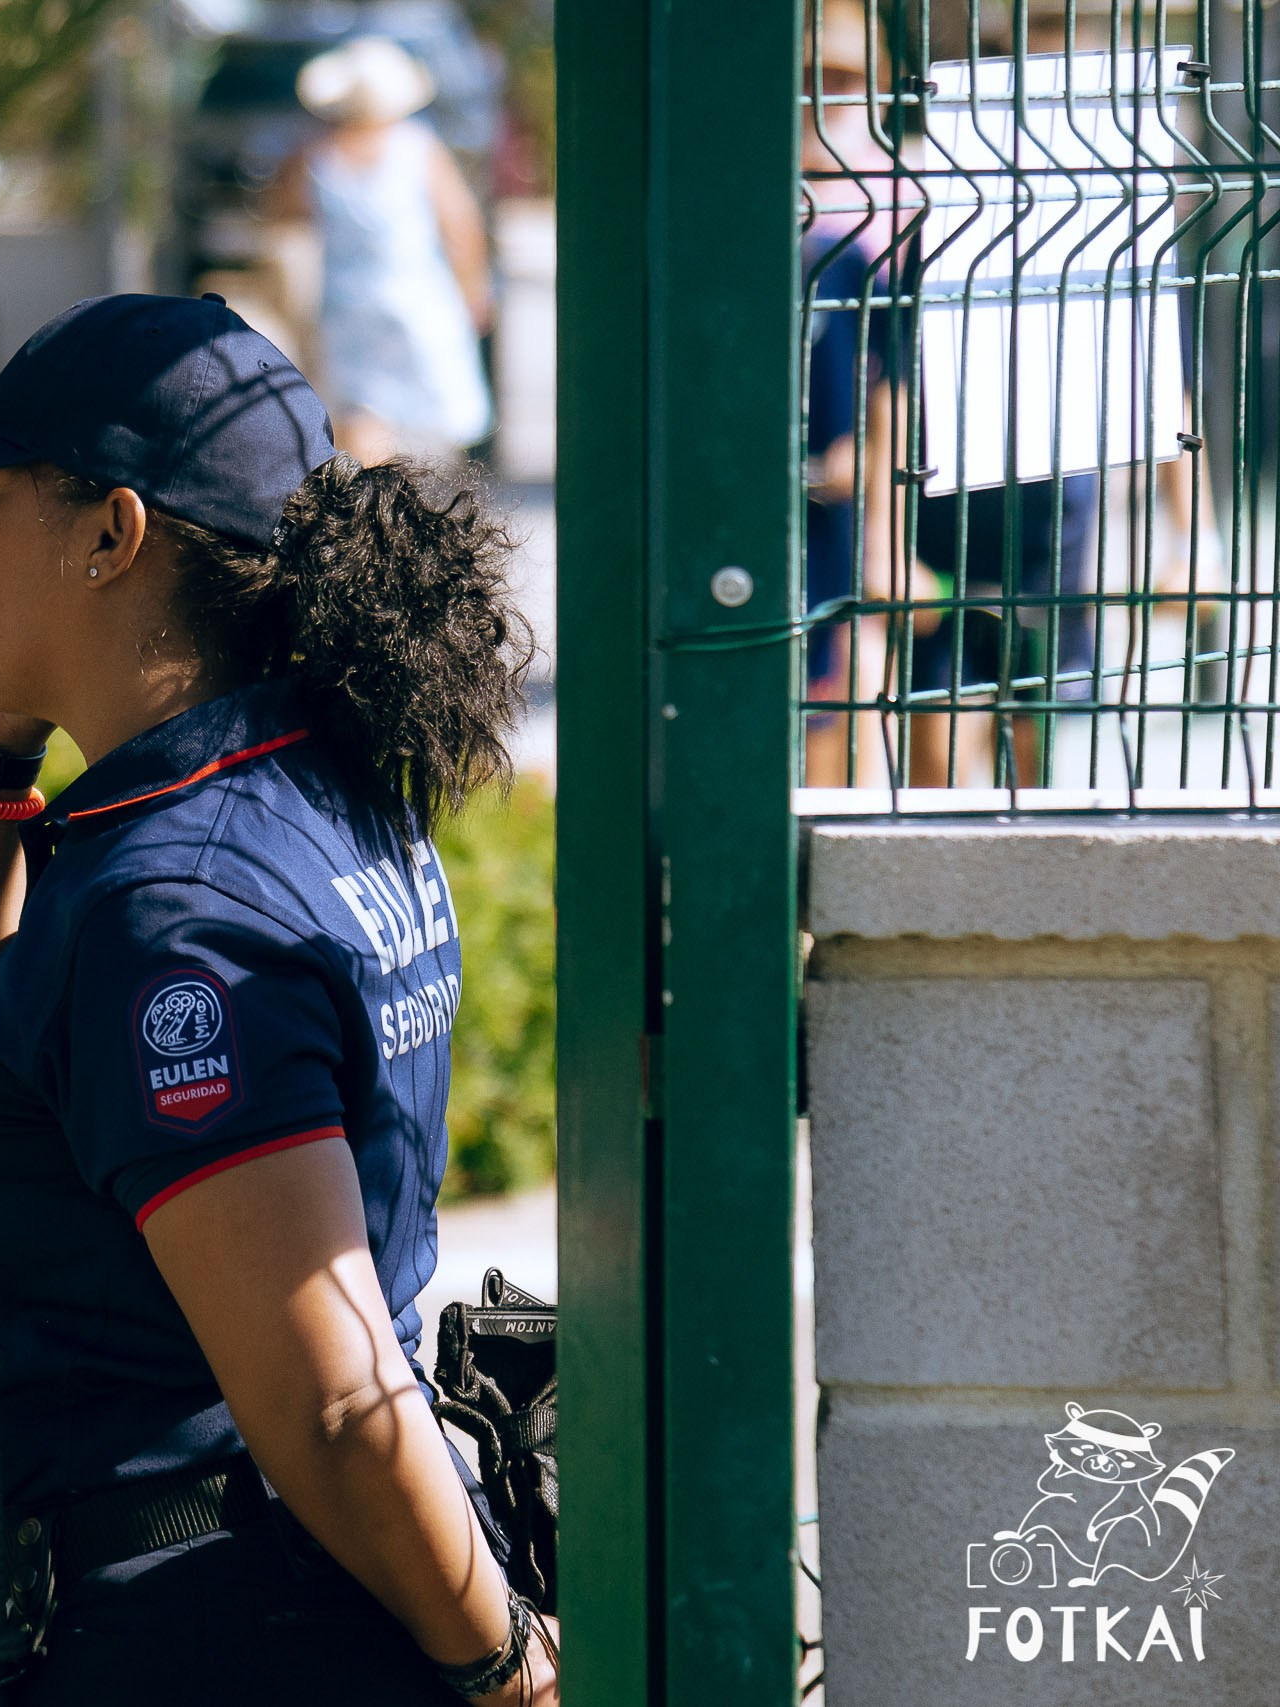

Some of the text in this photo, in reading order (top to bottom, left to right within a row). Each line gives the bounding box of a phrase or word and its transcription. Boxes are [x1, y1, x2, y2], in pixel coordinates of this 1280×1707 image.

[330, 835, 459, 976] EULE
[149, 1055, 229, 1090] EULEN
[160, 1083, 226, 1106] SEGURIDAD
